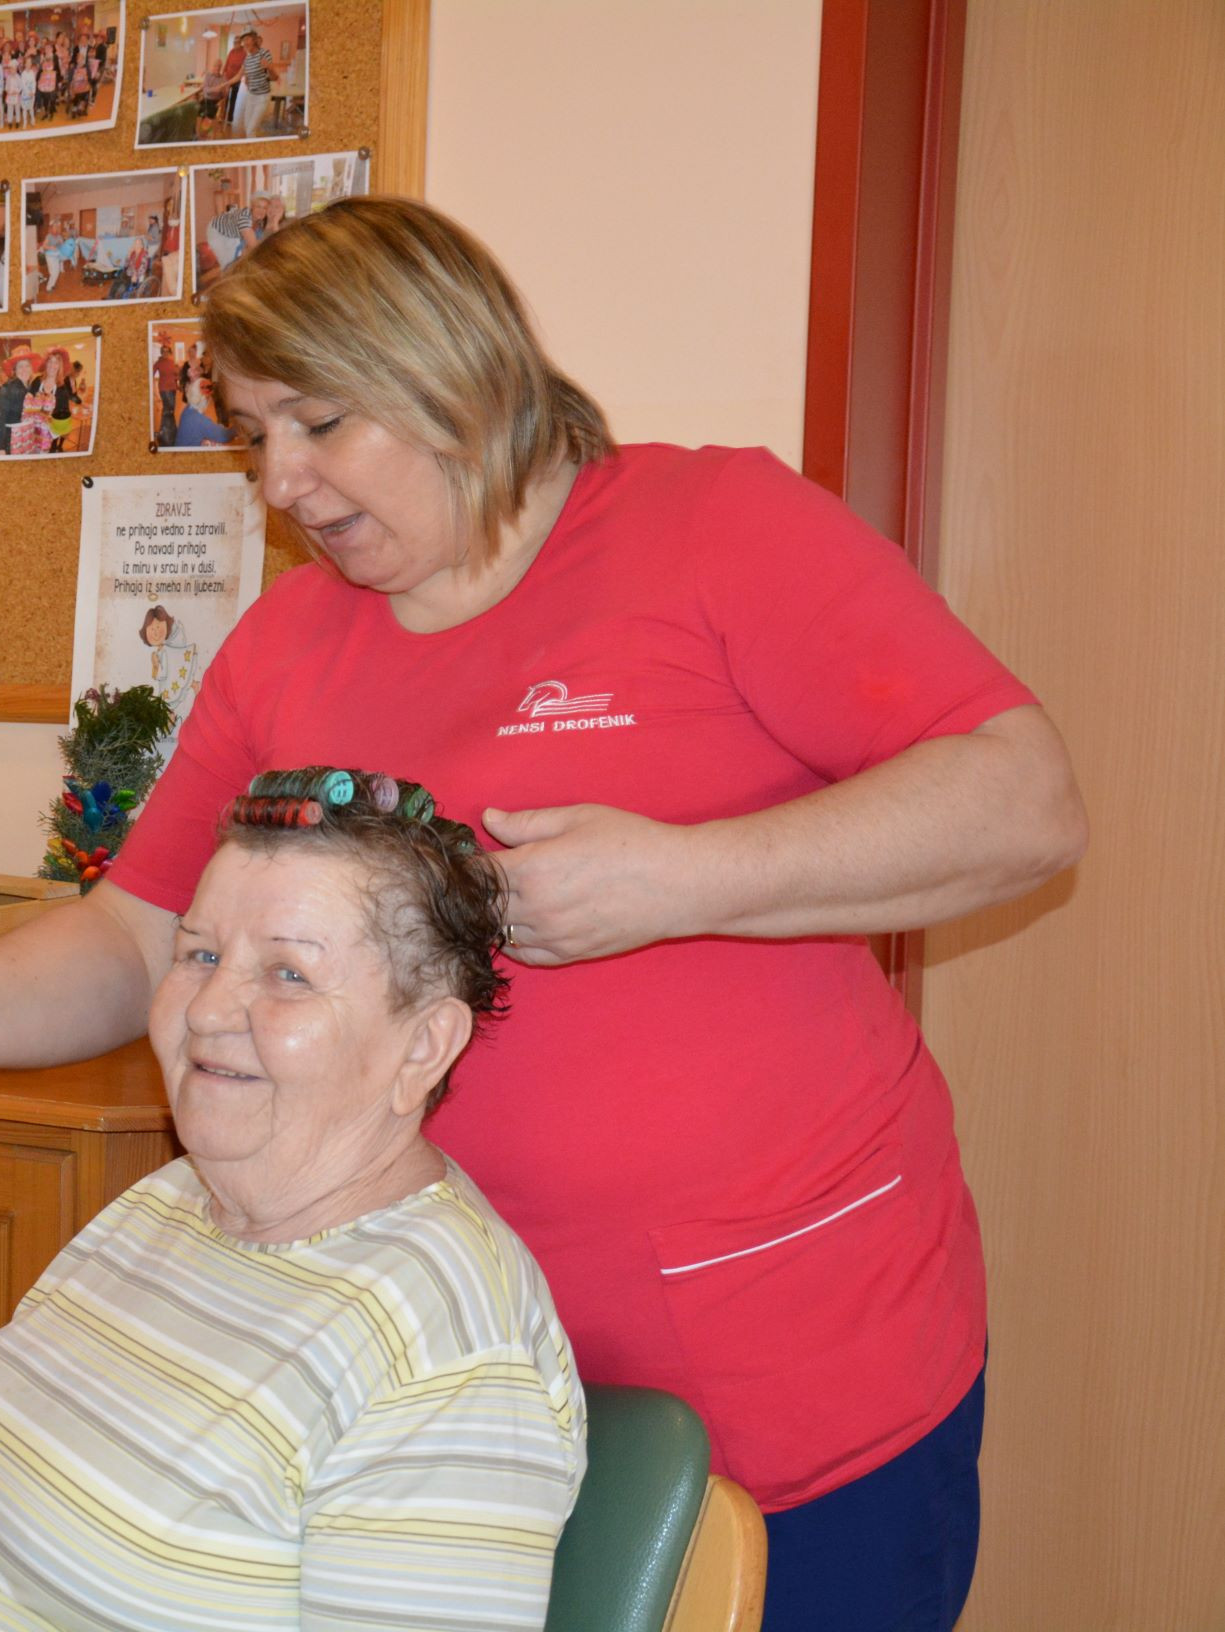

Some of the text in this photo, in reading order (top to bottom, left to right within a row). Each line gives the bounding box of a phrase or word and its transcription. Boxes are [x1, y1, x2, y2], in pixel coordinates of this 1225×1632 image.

[155, 502, 192, 517] ZDRAVJE
[116, 526, 126, 537] ne
[128, 523, 158, 540] prihaja
[161, 523, 185, 536] vedno
[187, 524, 193, 536] z
[134, 541, 207, 558] Po navadi prihaja
[122, 561, 130, 574] iz
[132, 561, 151, 574] miru
[153, 563, 158, 573] v
[160, 561, 179, 574] srcu
[181, 561, 189, 573] in
[191, 562, 196, 572] v
[114, 578, 143, 596] Prihaja
[145, 579, 152, 593] iz
[156, 579, 181, 593] smeha
[183, 580, 192, 593] in
[496, 714, 637, 737] NENSI DROFENIK
